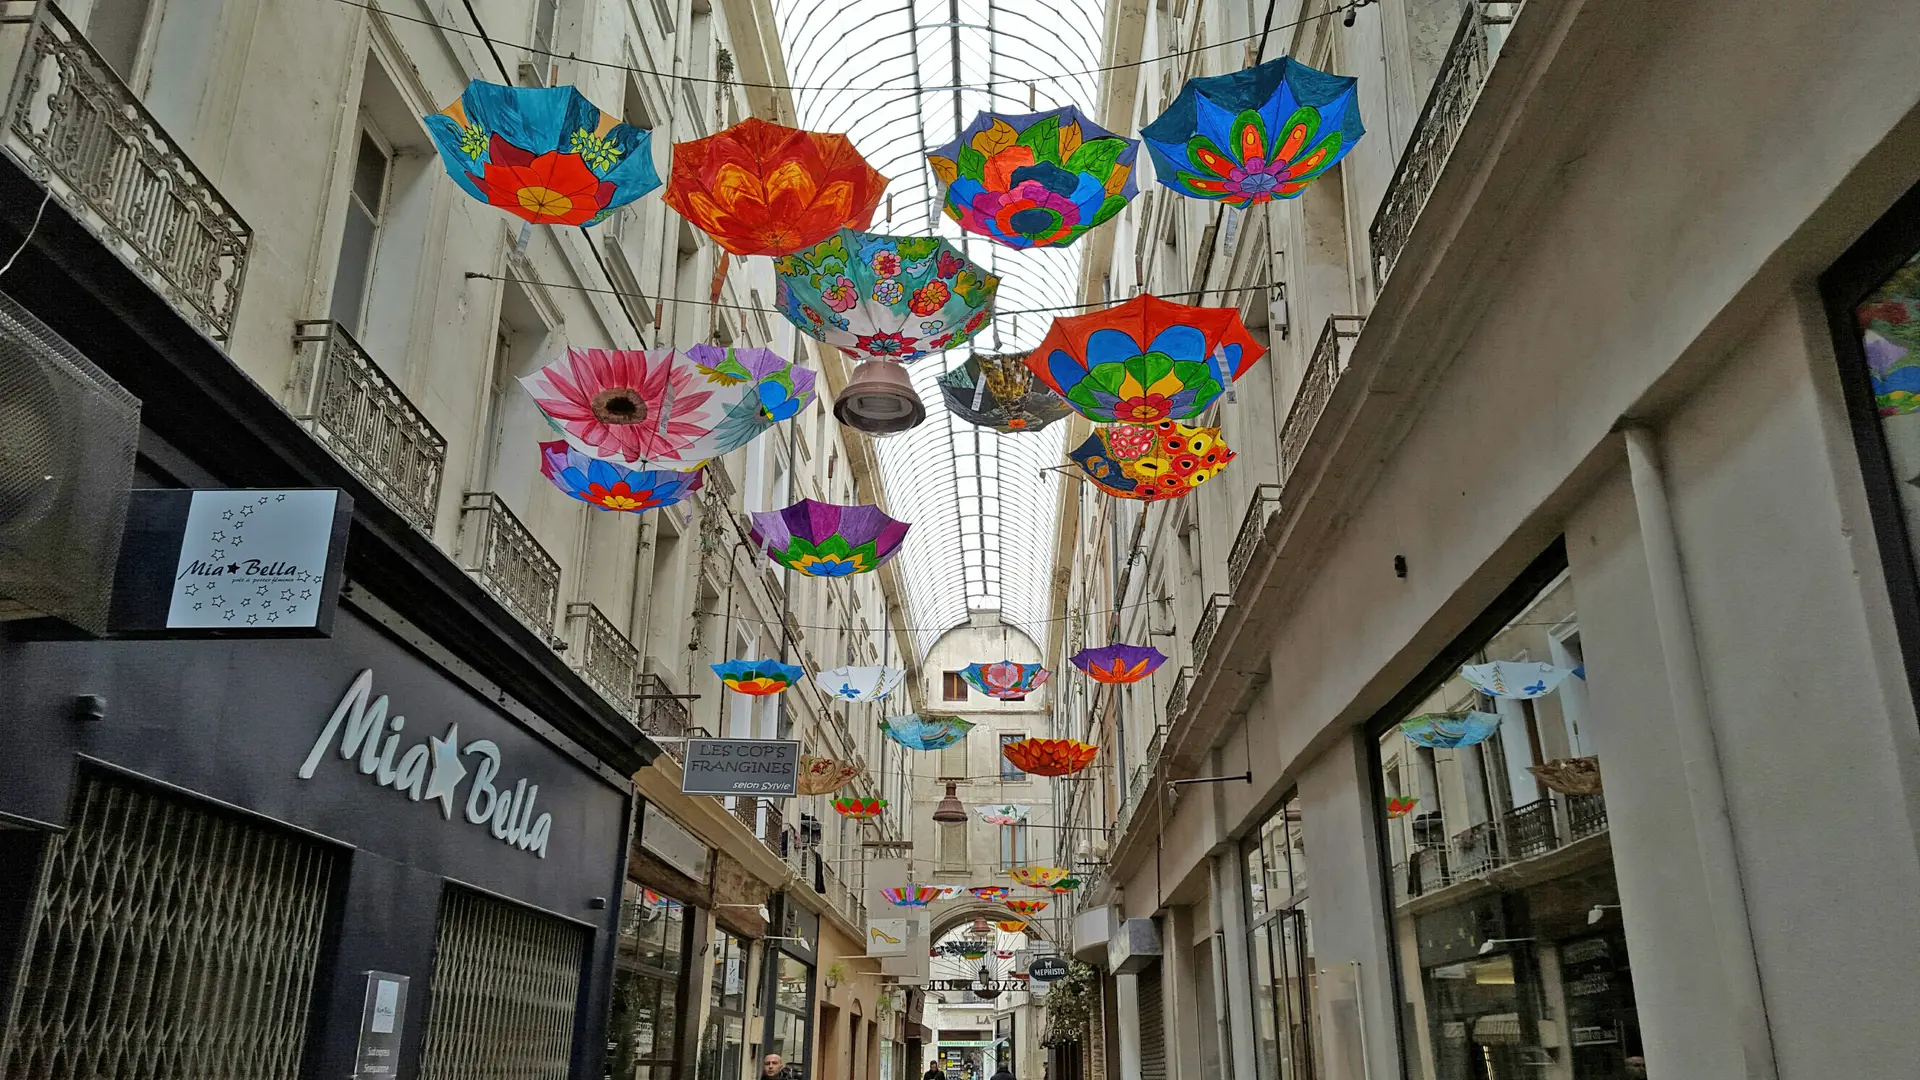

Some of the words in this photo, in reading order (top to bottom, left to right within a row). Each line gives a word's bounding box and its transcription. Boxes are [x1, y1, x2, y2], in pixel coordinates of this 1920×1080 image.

[177, 559, 224, 580] Mia
[242, 558, 297, 576] Bella
[298, 668, 431, 803] Mia
[462, 739, 553, 860] Bella
[690, 759, 793, 775] FRANGINES
[732, 781, 760, 790] selon
[760, 781, 791, 791] Sylvie
[1034, 967, 1065, 976] MEPHISTO
